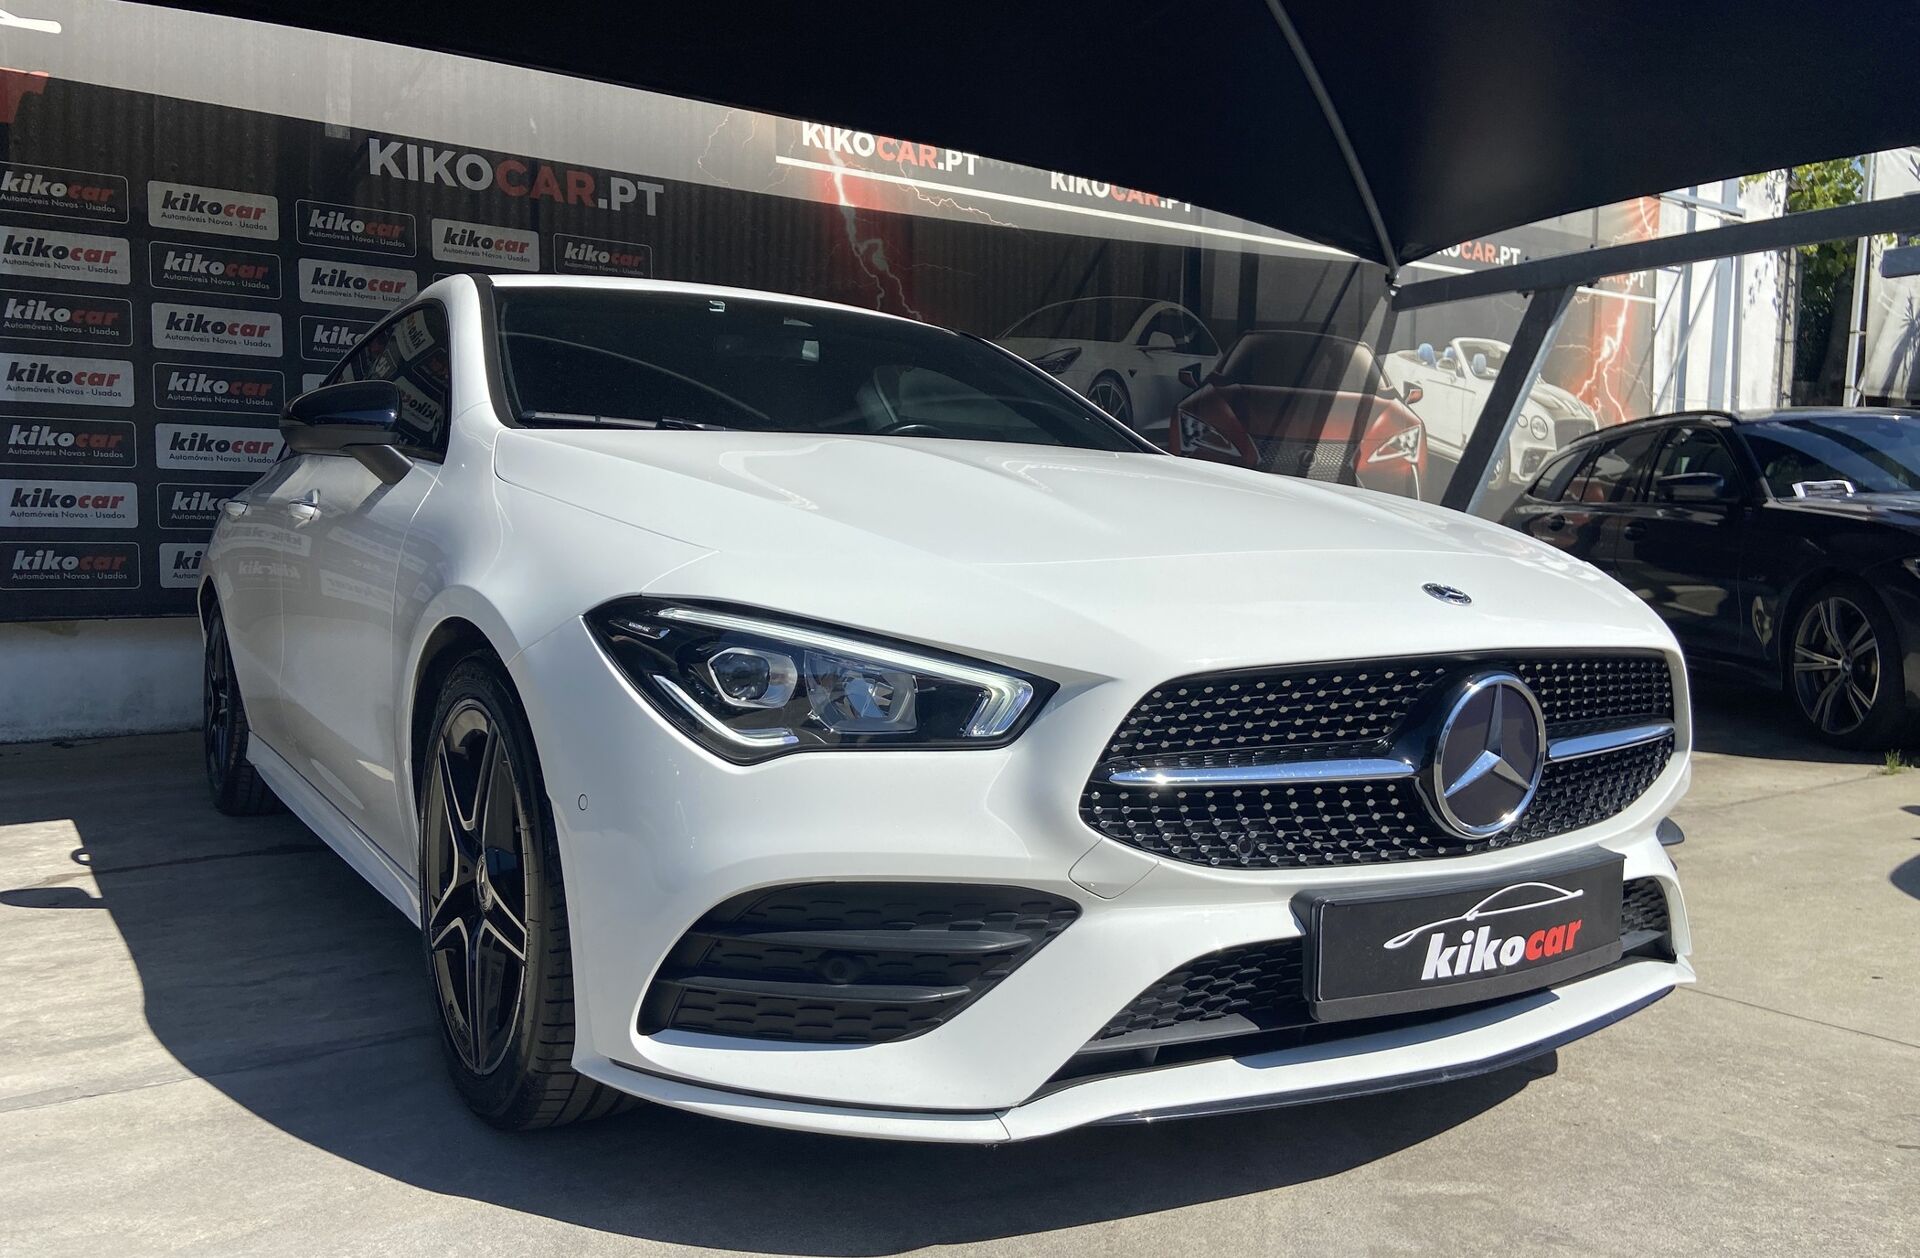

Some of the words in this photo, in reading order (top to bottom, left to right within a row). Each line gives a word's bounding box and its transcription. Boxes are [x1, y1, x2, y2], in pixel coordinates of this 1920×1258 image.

[802, 120, 980, 176] KIKOCAR.PT
[0, 171, 114, 202] kikocar
[368, 137, 664, 216] KIKOCAR.PT
[52, 200, 79, 209] Novos
[85, 203, 116, 213] Usados
[162, 190, 266, 220] kikocar
[208, 218, 233, 227] Novos
[240, 221, 268, 231] Usados
[309, 209, 405, 237] kikocar
[3, 235, 117, 264] kikocar
[443, 227, 529, 253] kikocar
[565, 242, 644, 267] kikocar
[1437, 240, 1521, 265] OCAR.PT
[54, 262, 80, 271] Novos
[88, 265, 118, 274] Usados
[164, 251, 269, 279] kikocar
[211, 277, 235, 286] Novos
[242, 280, 270, 290] Usados
[311, 267, 406, 293] kikocar
[4, 298, 119, 326] kikocar
[55, 325, 81, 333] Novos
[89, 327, 119, 336] Usados
[165, 312, 270, 338] kikocar
[212, 337, 237, 345] Novos
[244, 339, 271, 348] Usados
[6, 362, 120, 387] kikocar
[167, 372, 272, 396] kikocar
[58, 387, 84, 395] Novos
[91, 389, 121, 397] Usados
[215, 396, 239, 404] Novos
[246, 398, 273, 406] Usados
[8, 424, 122, 448] kikocar
[170, 432, 274, 454] kikocar
[59, 449, 86, 457] Novos
[216, 455, 241, 463] Novos
[248, 456, 275, 464] Usados
[10, 488, 125, 509] kikocar
[61, 511, 88, 519] Novos
[95, 511, 126, 519] Usados
[12, 550, 127, 571] kikocar
[63, 572, 90, 580] Novos
[97, 571, 127, 580] Usados
[1420, 919, 1583, 981] kikocar
